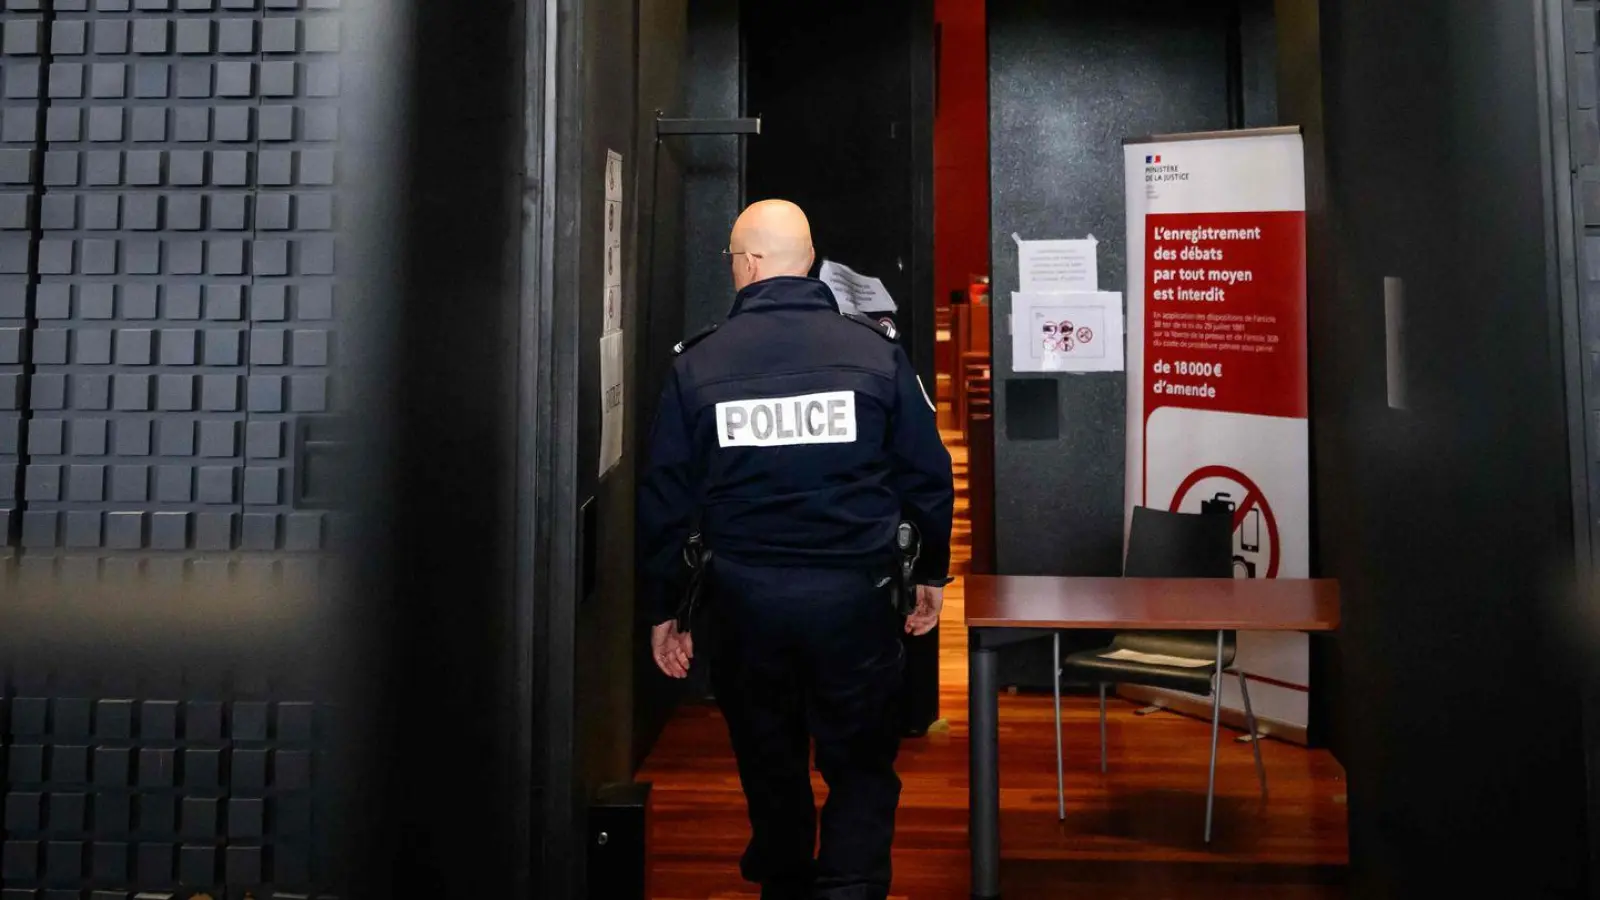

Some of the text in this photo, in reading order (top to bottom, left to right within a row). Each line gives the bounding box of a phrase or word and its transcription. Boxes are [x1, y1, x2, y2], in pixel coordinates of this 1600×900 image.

[1164, 172, 1189, 182] JUSTICE
[1154, 225, 1261, 244] L'enregistrement
[1153, 245, 1223, 261] des débats
[1153, 268, 1253, 285] par tout moyen
[1153, 287, 1225, 302] est interdit
[1153, 359, 1171, 374] de
[1153, 379, 1216, 398] d'amende
[725, 399, 848, 441] POLICE
